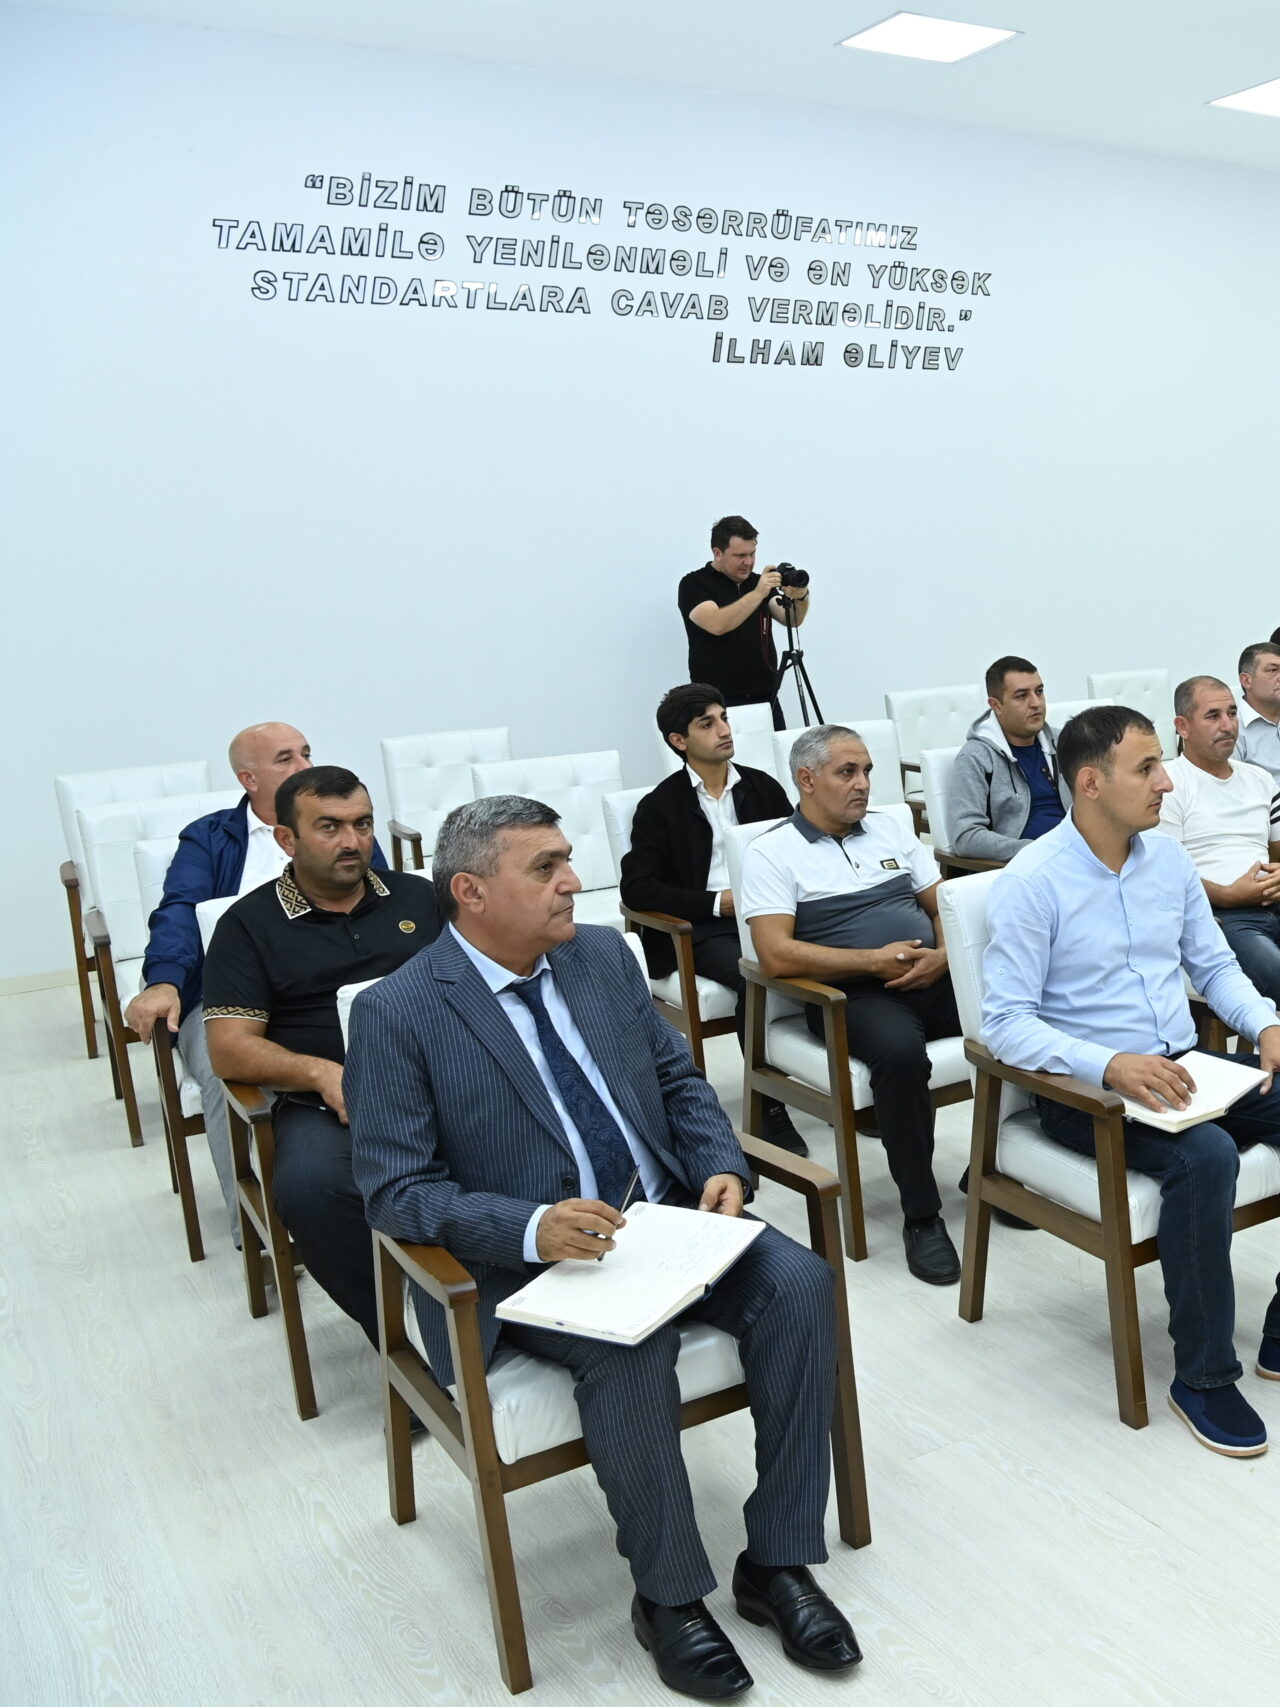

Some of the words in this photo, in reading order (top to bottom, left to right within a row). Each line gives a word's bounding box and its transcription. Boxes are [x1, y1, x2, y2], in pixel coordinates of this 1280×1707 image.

[304, 172, 446, 213] “BİZİM
[468, 184, 603, 225] BÜTÜN
[623, 201, 918, 252] TƏSƏRRÜFATIMIZ
[212, 218, 445, 261] TAMAMİLƏ
[466, 234, 728, 279] YENİLƏNMƏLİ
[745, 255, 790, 283] VƏ
[807, 259, 851, 288] ƏN
[866, 260, 992, 296] YÜKSƏK
[251, 270, 591, 314] STANDARTLARA
[611, 289, 729, 321] CAVAB
[747, 296, 972, 332] VERMƏLİDİR.”
[712, 331, 824, 367] İLHAM
[843, 339, 964, 372] ƏLİYEV
